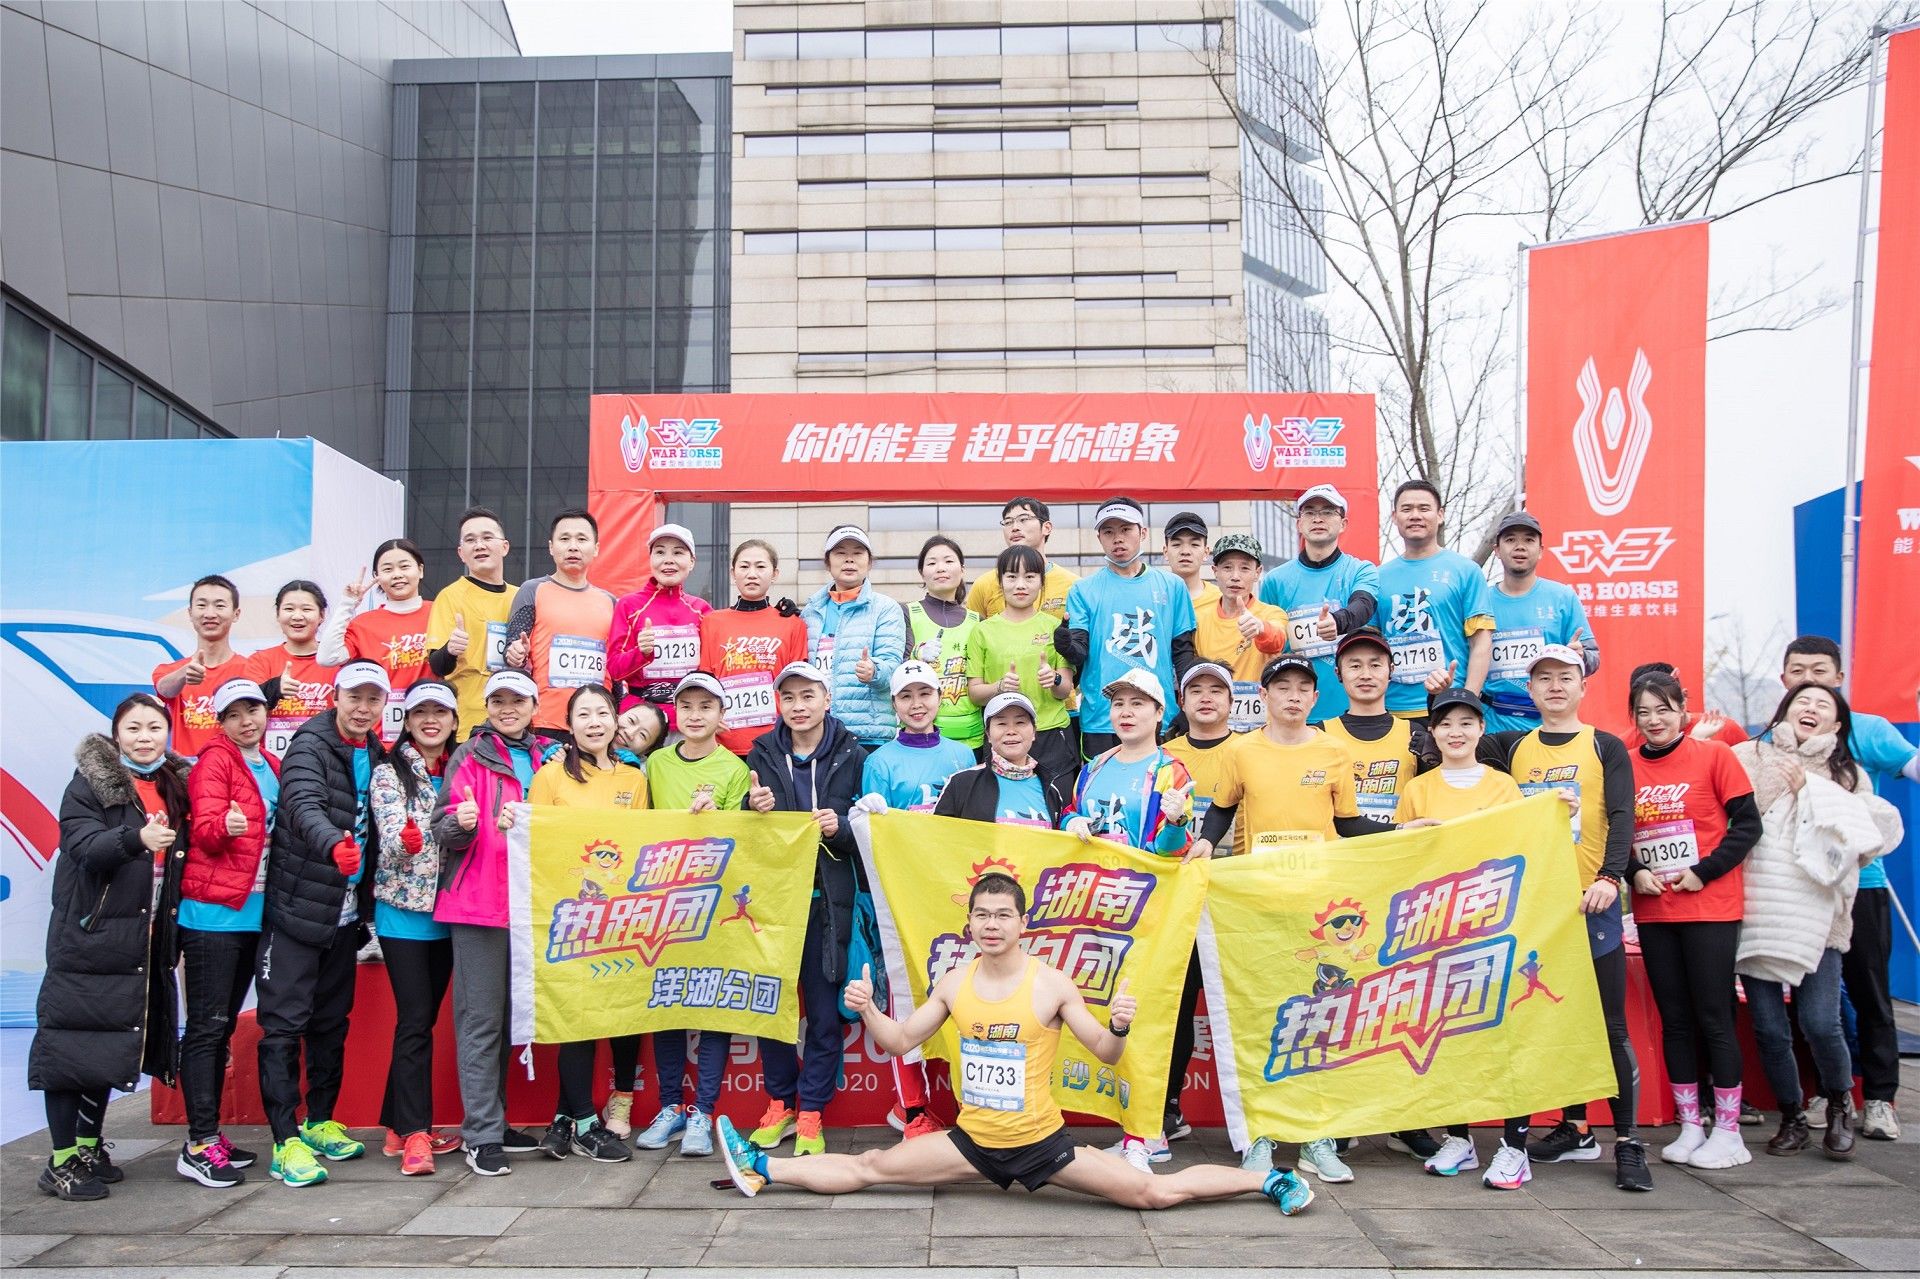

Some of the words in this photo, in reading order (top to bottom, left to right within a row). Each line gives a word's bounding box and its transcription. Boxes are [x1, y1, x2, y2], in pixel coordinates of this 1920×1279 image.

[652, 449, 677, 458] WAR
[680, 449, 720, 458] HORSE
[782, 423, 958, 463] 你的能量
[962, 422, 1180, 463] 超乎你想象
[1276, 448, 1300, 456] WAR
[1304, 447, 1344, 457] HORSE
[1596, 581, 1679, 599] HORSE
[559, 652, 603, 671] C1726
[1392, 647, 1437, 666] C1718
[1492, 643, 1538, 662] C1723
[1230, 699, 1261, 714] 716
[1260, 834, 1277, 843] 2020
[634, 842, 731, 886] 湖南
[1641, 841, 1690, 864] D1302
[1034, 870, 1150, 925] 湖南
[1392, 863, 1516, 957] 湖南
[549, 890, 715, 958] 热跑团
[648, 967, 781, 1014] 洋湖分团
[1269, 941, 1511, 1075] 热跑团
[839, 1075, 878, 1092] 020
[966, 1062, 1016, 1086] C1733
[1050, 1058, 1131, 1109] 沙分团
